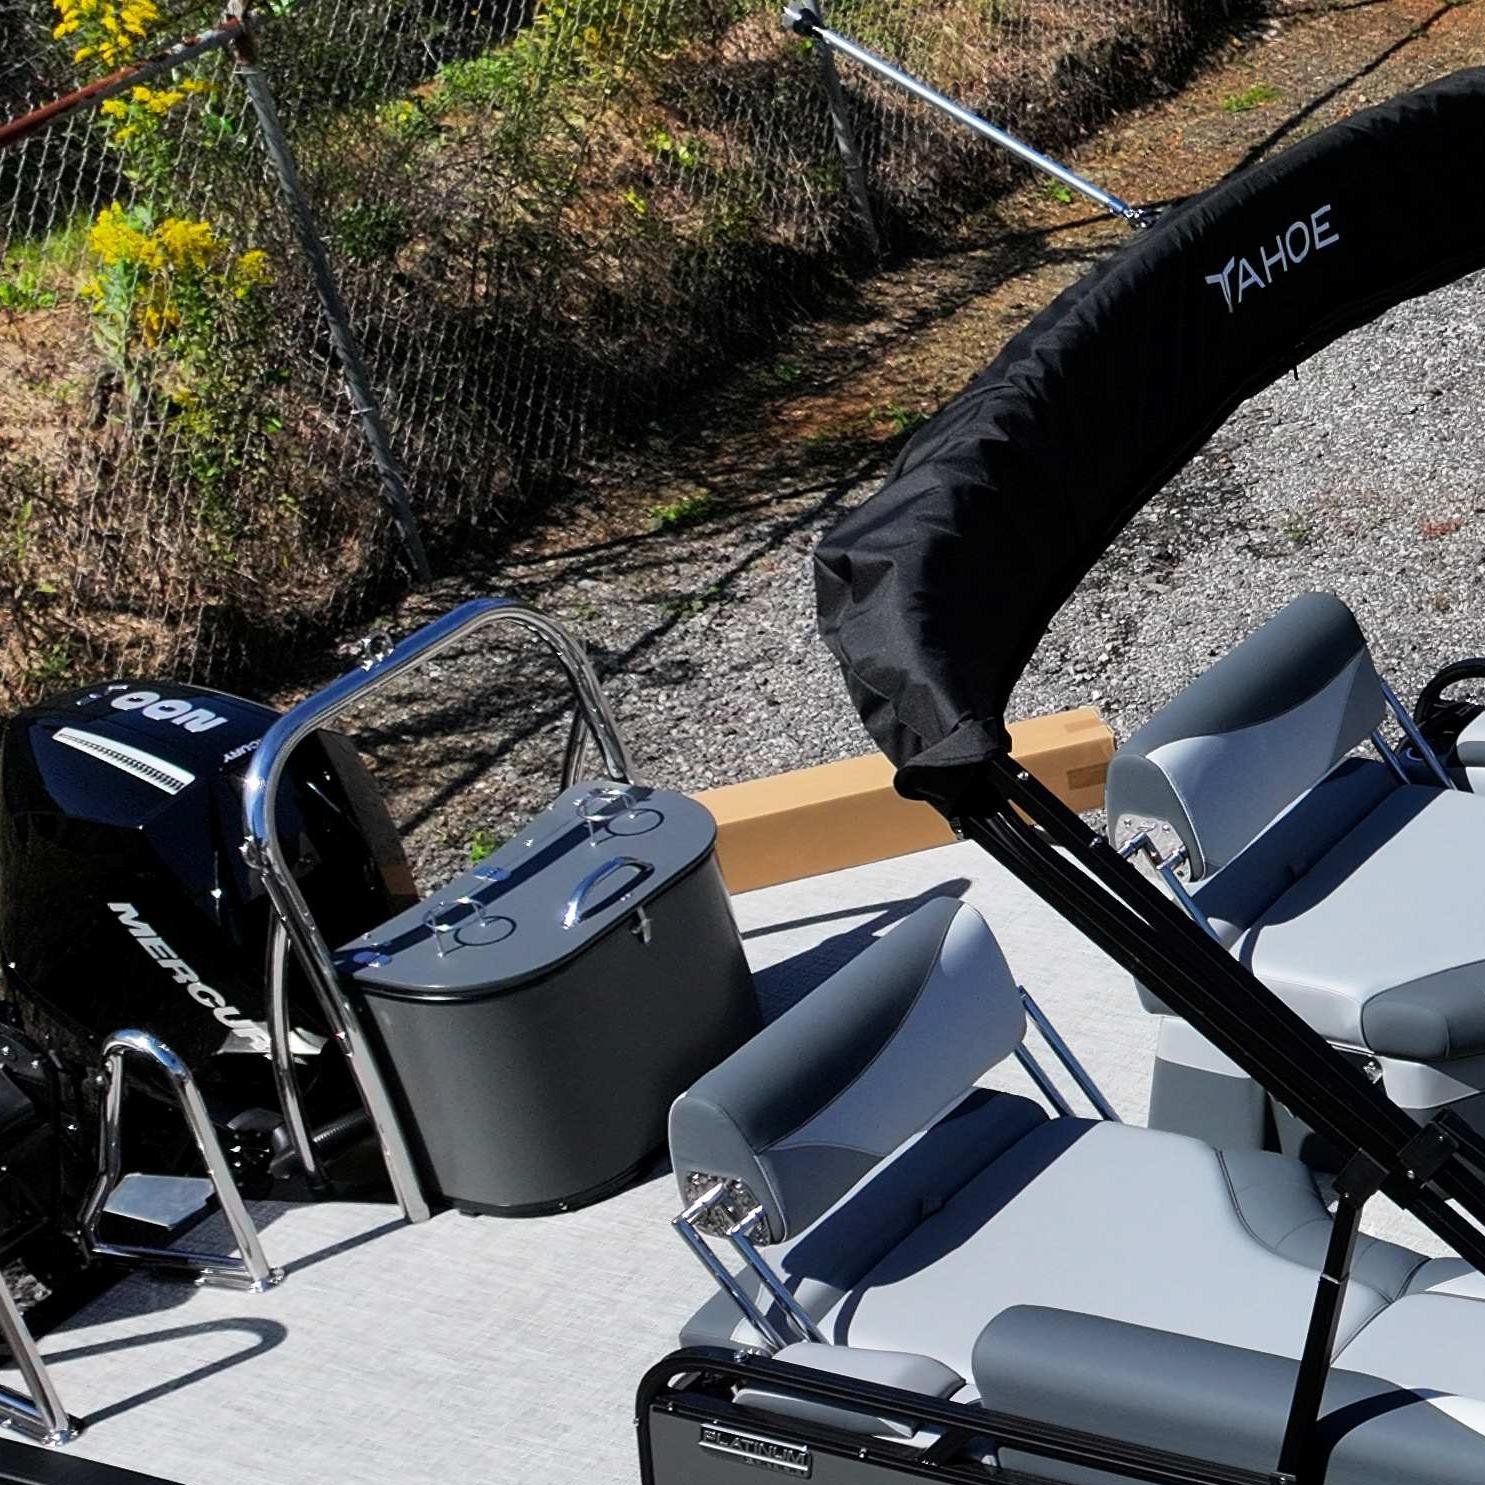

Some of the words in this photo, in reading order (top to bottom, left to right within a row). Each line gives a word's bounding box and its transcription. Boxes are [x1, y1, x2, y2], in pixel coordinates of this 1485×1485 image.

[1204, 203, 1340, 313] TAHOE
[106, 901, 275, 1060] MERCUR
[703, 1429, 807, 1466] PLATINUM
